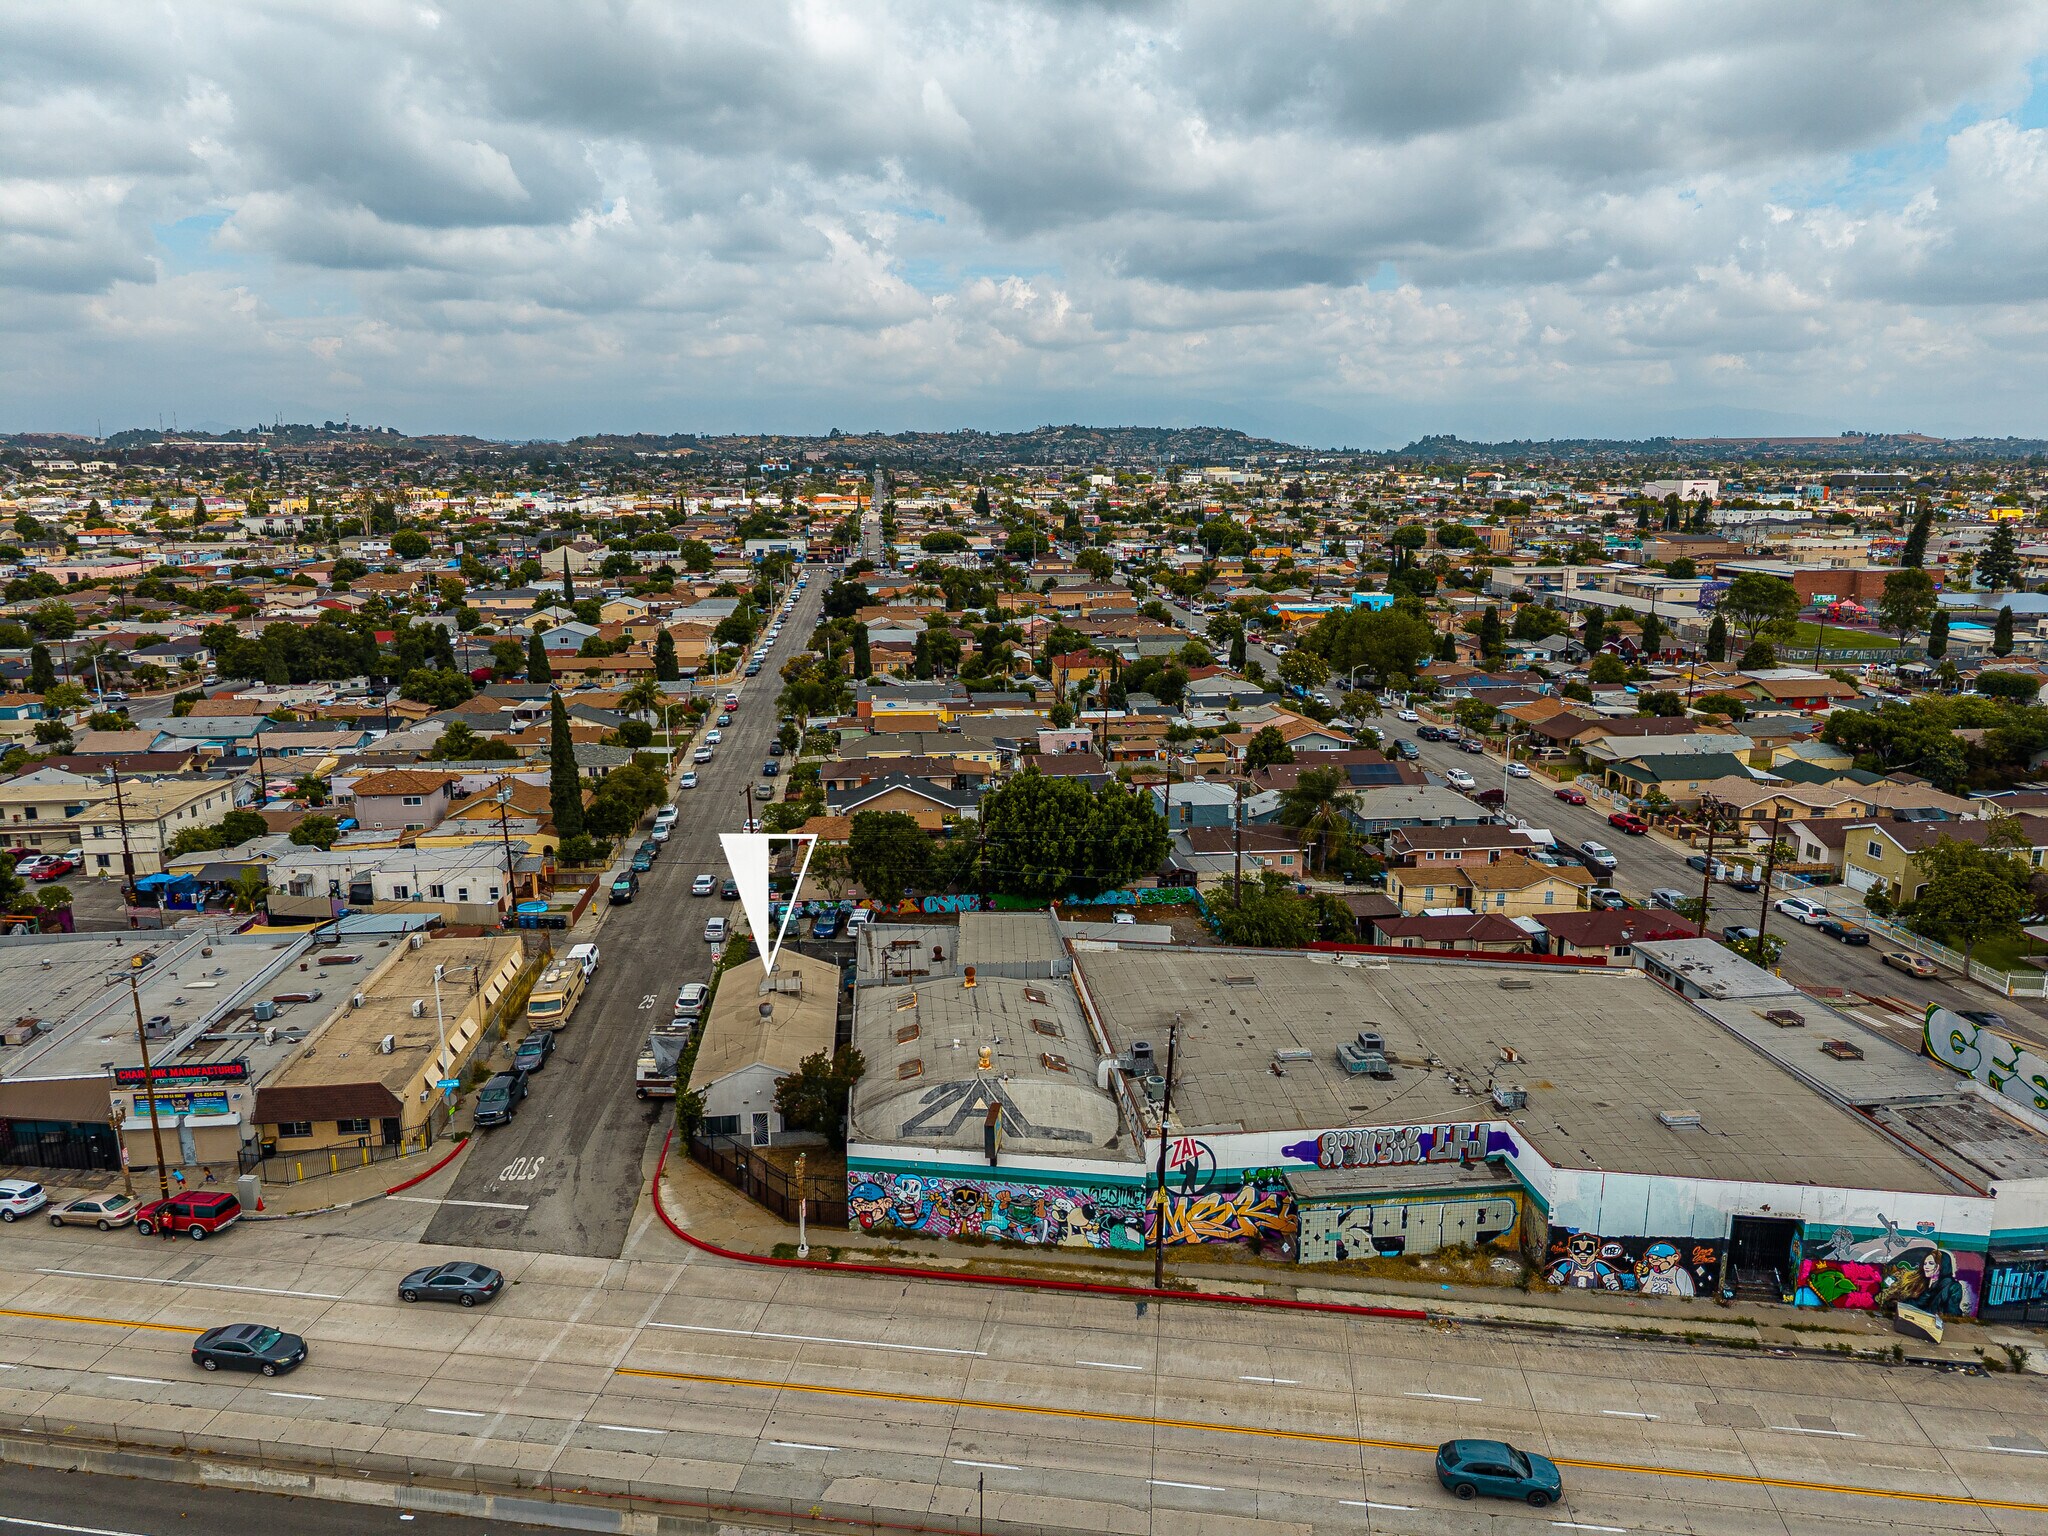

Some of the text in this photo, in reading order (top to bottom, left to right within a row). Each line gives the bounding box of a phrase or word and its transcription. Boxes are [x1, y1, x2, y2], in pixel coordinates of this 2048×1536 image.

[1834, 649, 1908, 660] ELEMENTARY
[637, 994, 658, 1009] 25
[169, 1064, 243, 1077] MANUFACTURER
[898, 1078, 1093, 1144] ZAL
[1170, 1137, 1205, 1168] ZAL
[499, 1156, 546, 1181] STOP
[1651, 1282, 1669, 1294] 24
